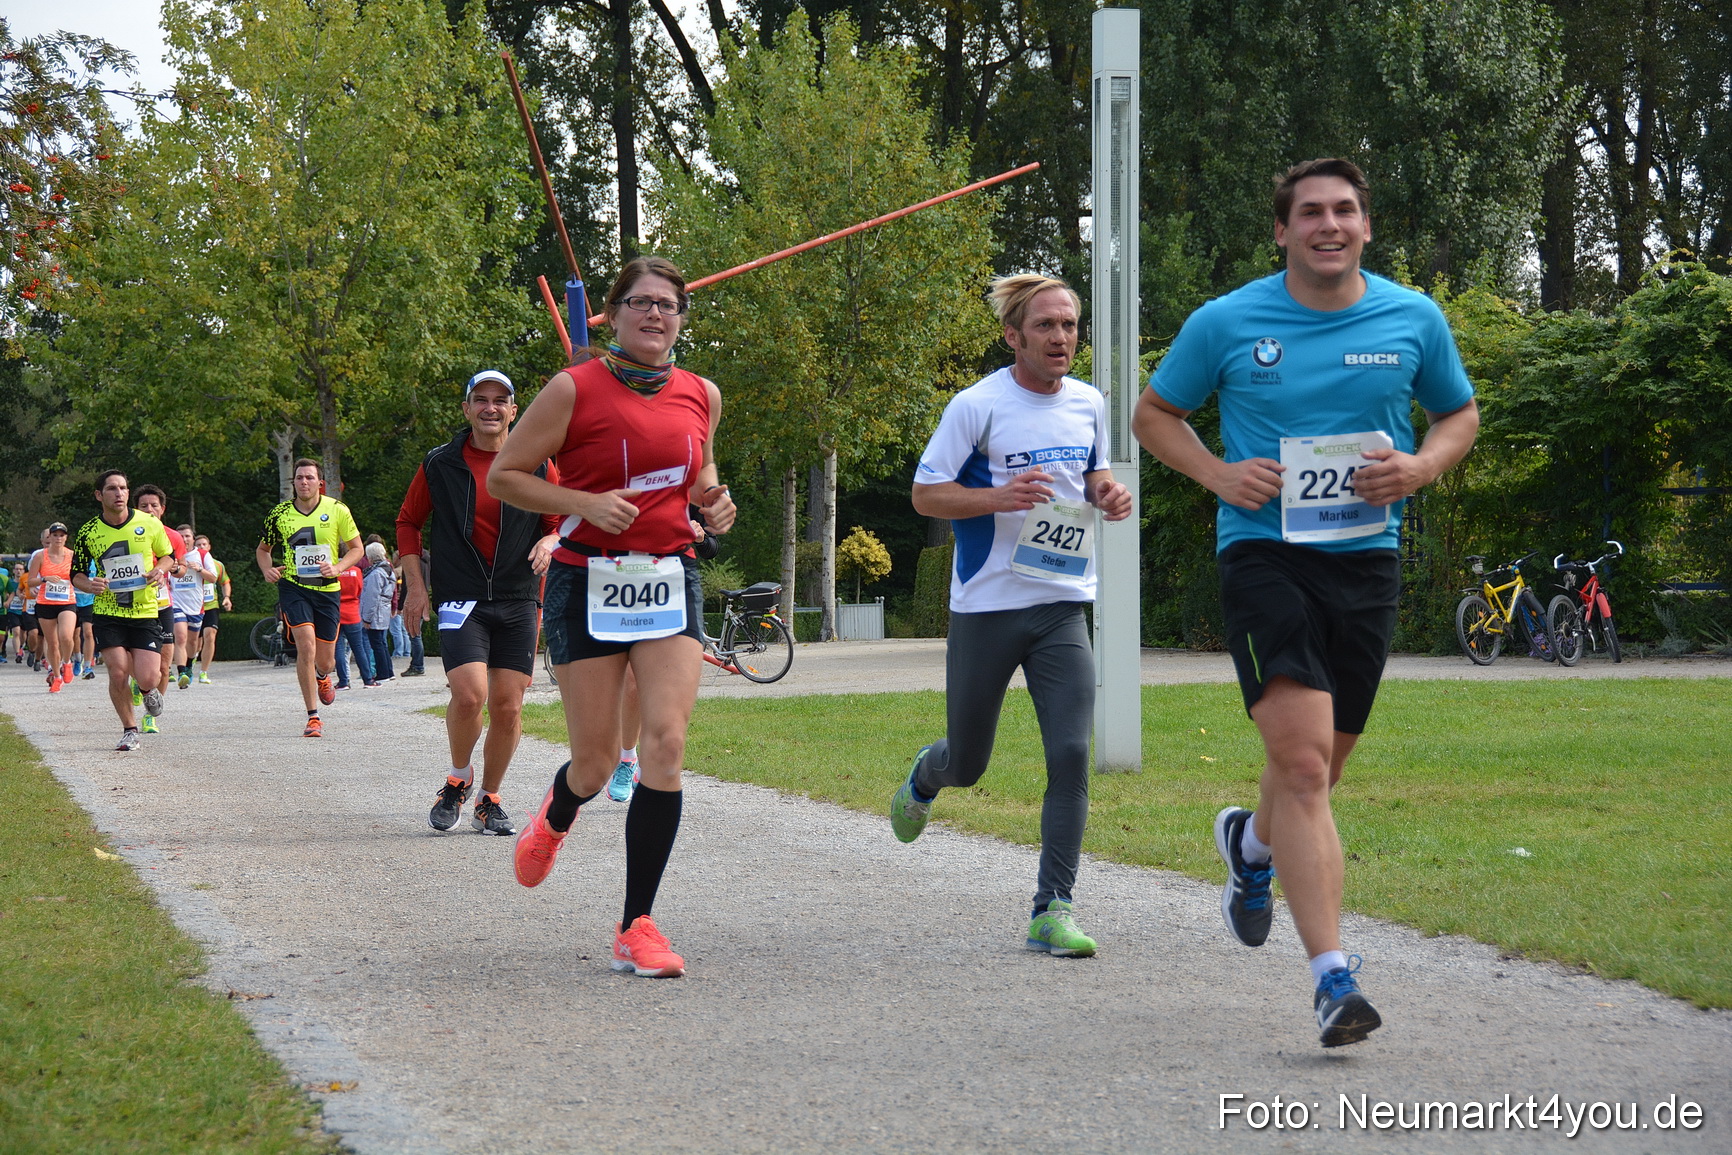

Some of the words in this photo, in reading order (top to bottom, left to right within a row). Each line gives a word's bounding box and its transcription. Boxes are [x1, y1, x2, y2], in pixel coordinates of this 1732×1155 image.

[1344, 353, 1400, 365] BOCK
[1250, 371, 1282, 380] PARTL
[1325, 443, 1361, 454] BOCK
[1035, 449, 1087, 461] BÜSCHEL
[645, 474, 671, 486] DEHN
[1299, 464, 1373, 501] 224
[1319, 509, 1359, 522] Markus
[1031, 520, 1085, 552] 2427
[302, 554, 326, 565] 2682
[1041, 555, 1066, 567] Stefan
[111, 565, 140, 580] 2694
[603, 582, 669, 608] 2040
[620, 617, 654, 626] Andrea
